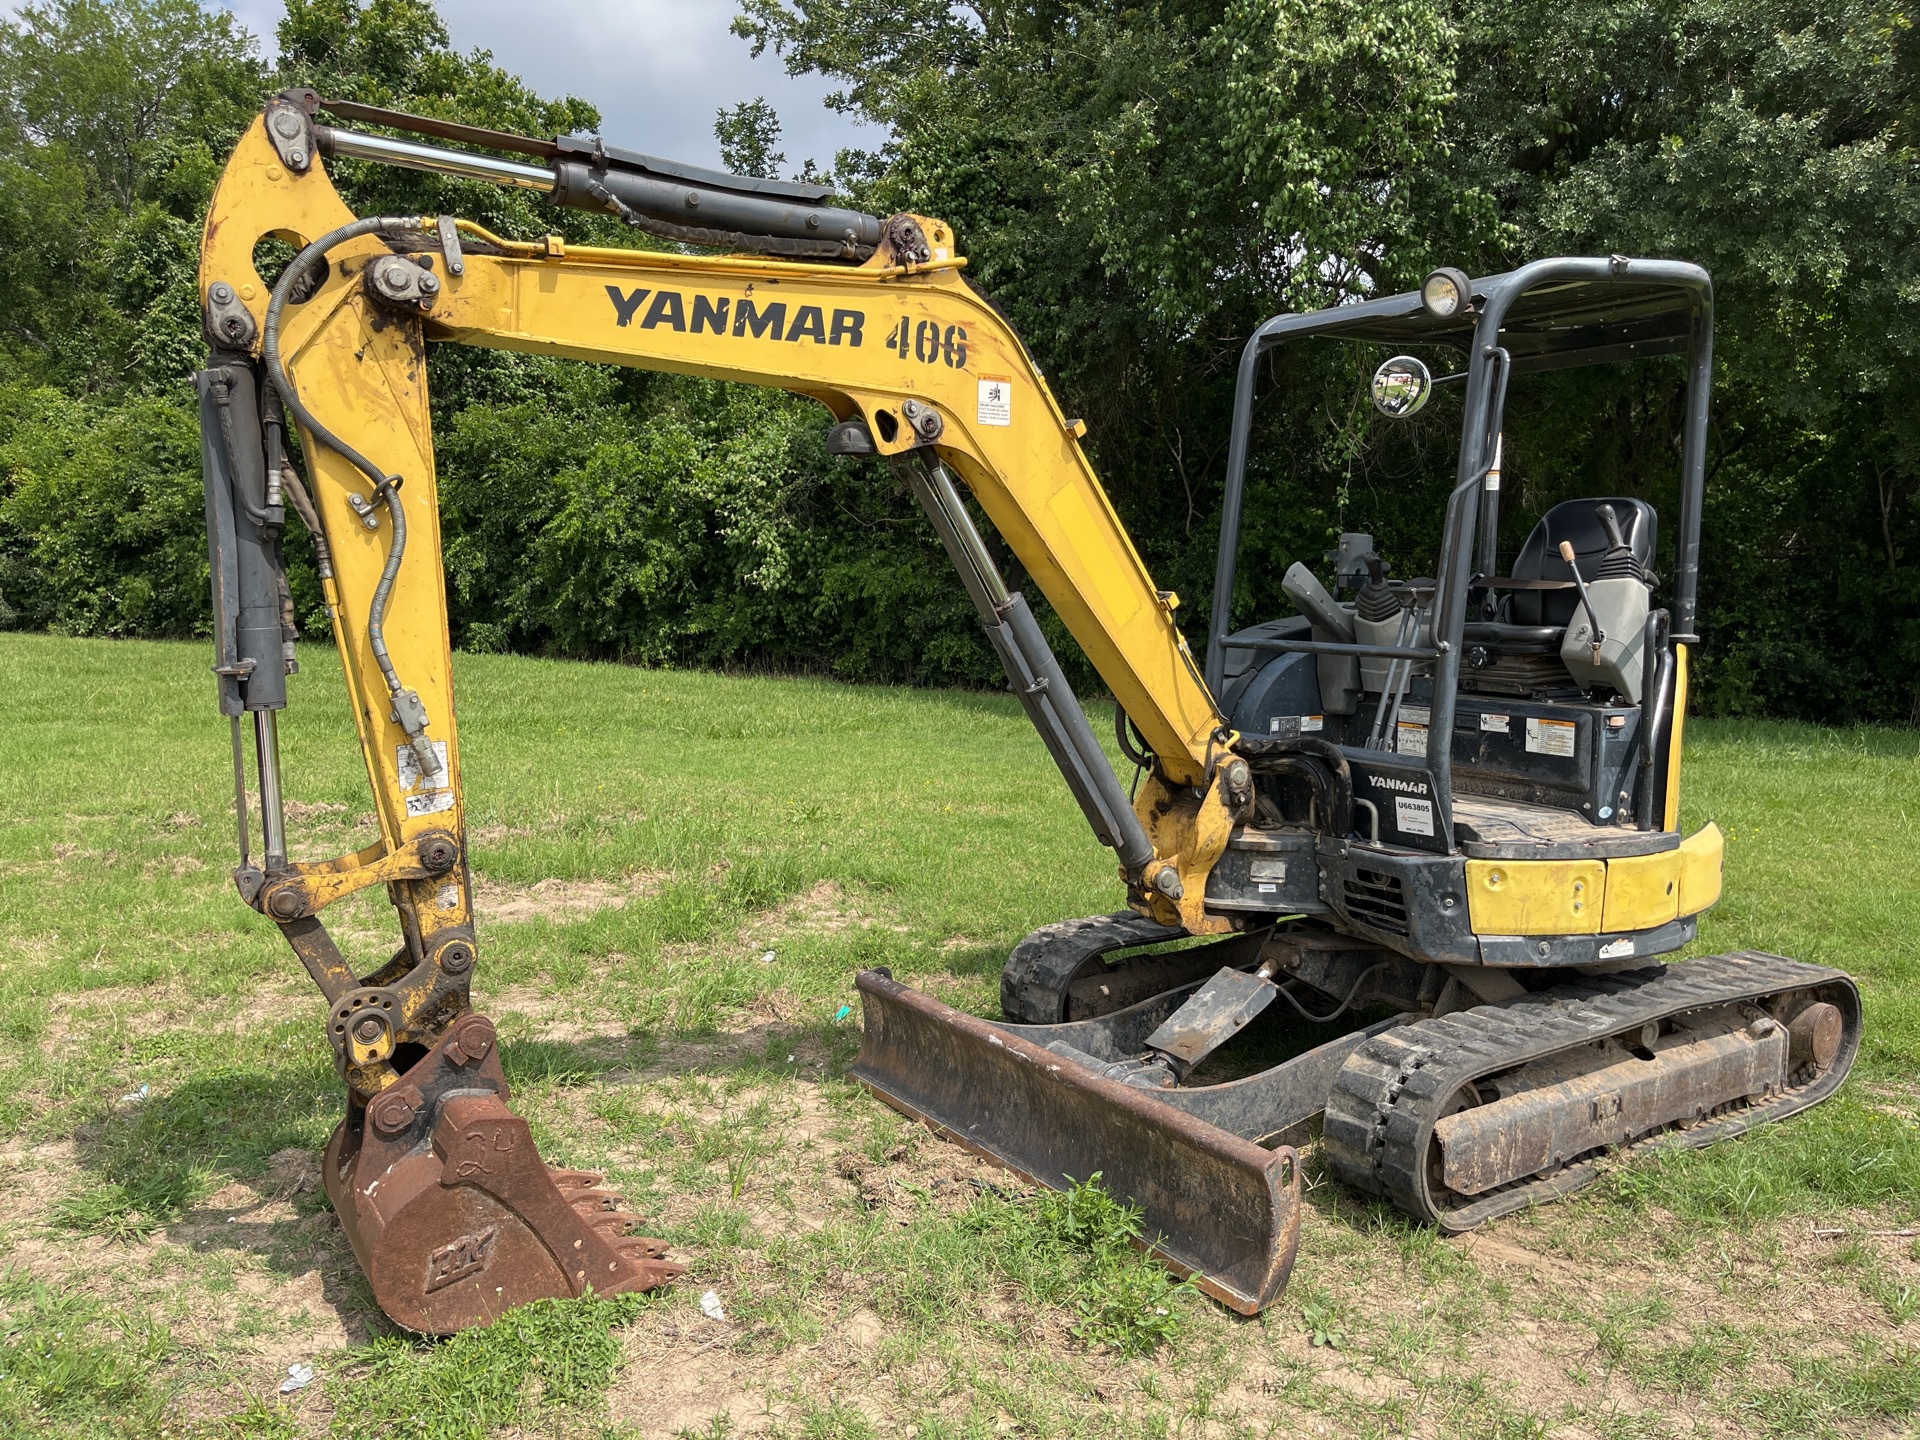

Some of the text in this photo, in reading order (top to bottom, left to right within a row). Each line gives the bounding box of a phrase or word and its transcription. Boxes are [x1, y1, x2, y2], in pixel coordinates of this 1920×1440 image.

[604, 284, 866, 348] YANMAR
[1368, 775, 1428, 795] YANMAR
[1398, 801, 1430, 812] U663805
